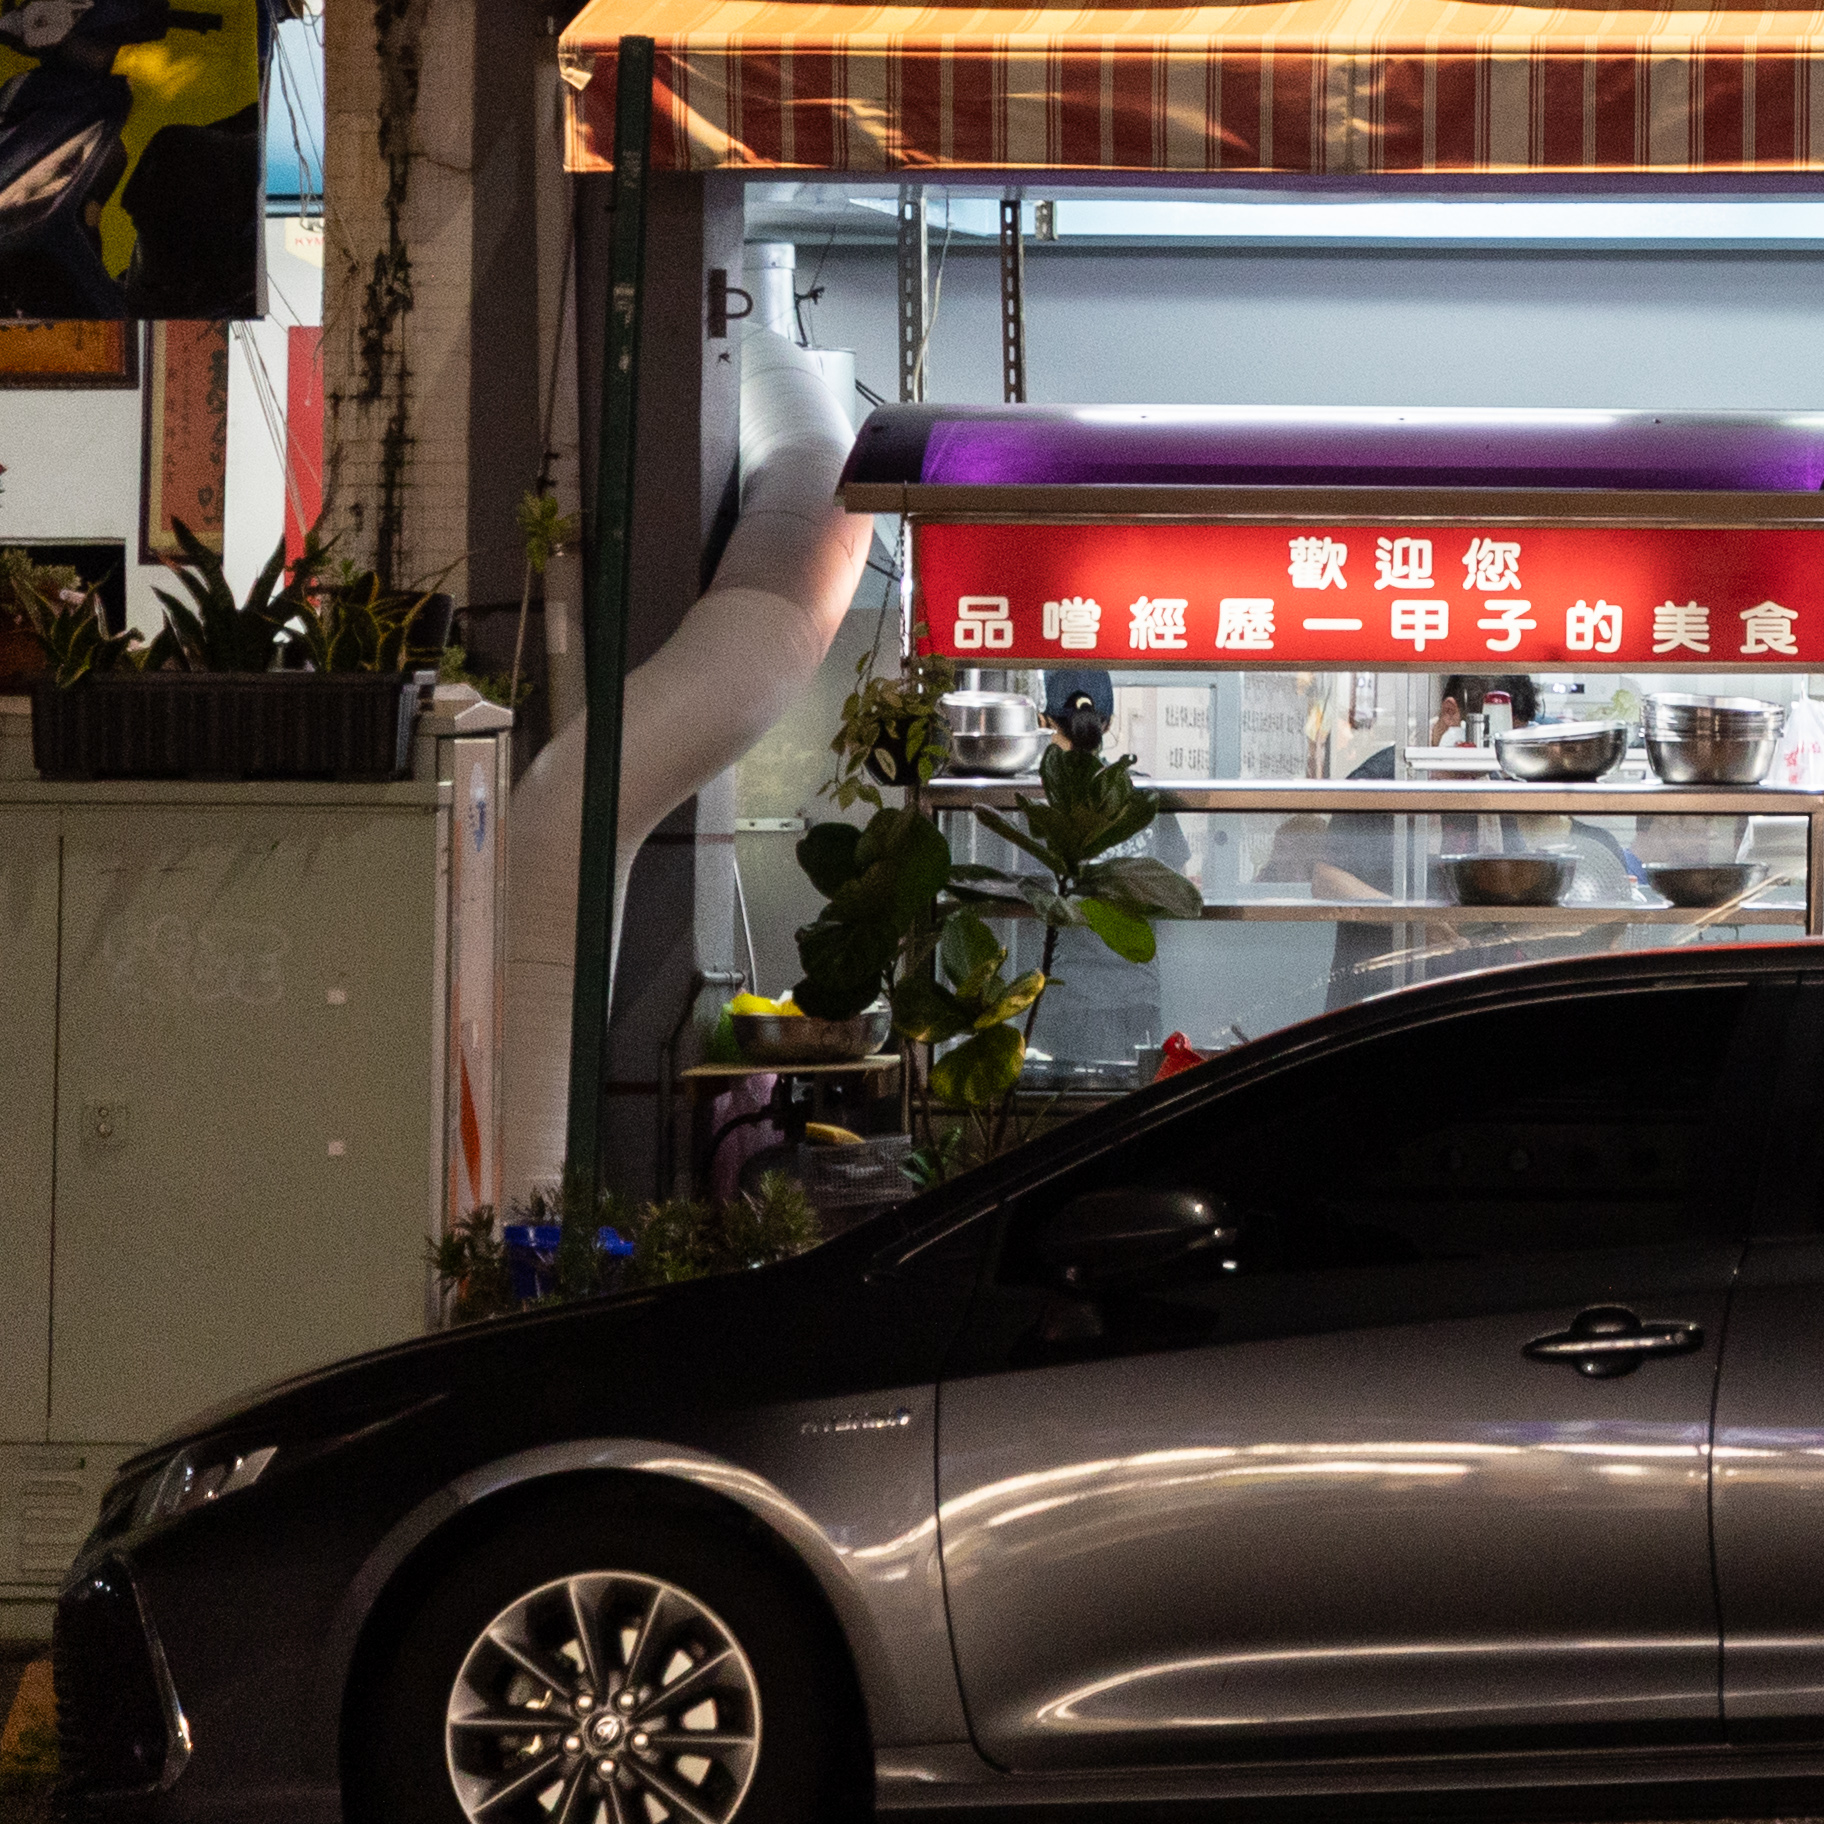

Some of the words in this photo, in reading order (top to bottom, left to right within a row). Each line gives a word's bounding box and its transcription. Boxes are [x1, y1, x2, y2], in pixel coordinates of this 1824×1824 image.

[1288, 537, 1521, 591] 歡迎您
[954, 596, 1799, 655] 品嚐經歷一甲子的美食
